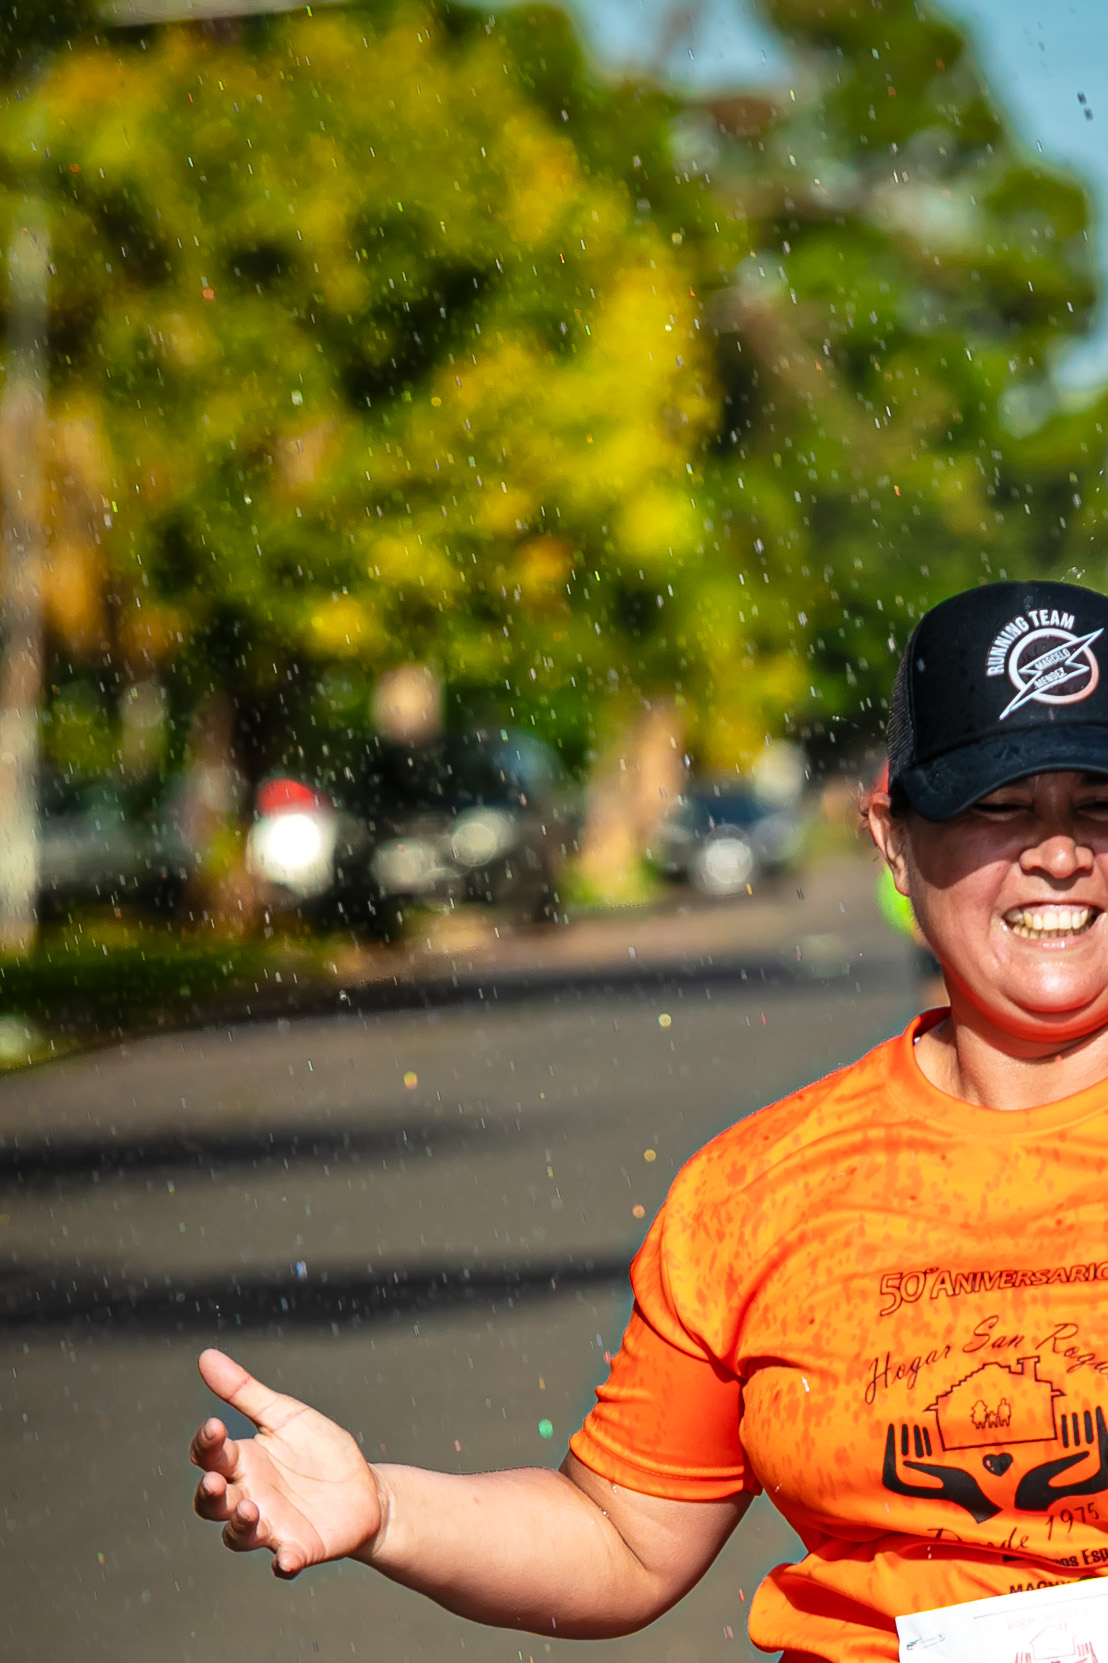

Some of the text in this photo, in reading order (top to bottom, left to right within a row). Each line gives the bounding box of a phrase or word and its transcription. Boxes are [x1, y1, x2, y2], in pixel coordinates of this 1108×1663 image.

[986, 609, 1075, 677] RUNNING TEAM
[1034, 648, 1071, 671] MARCELO
[1033, 666, 1068, 689] MENDEZ
[864, 1345, 951, 1405] Hogar
[962, 1315, 1025, 1353] San
[1045, 1502, 1100, 1542] 1975
